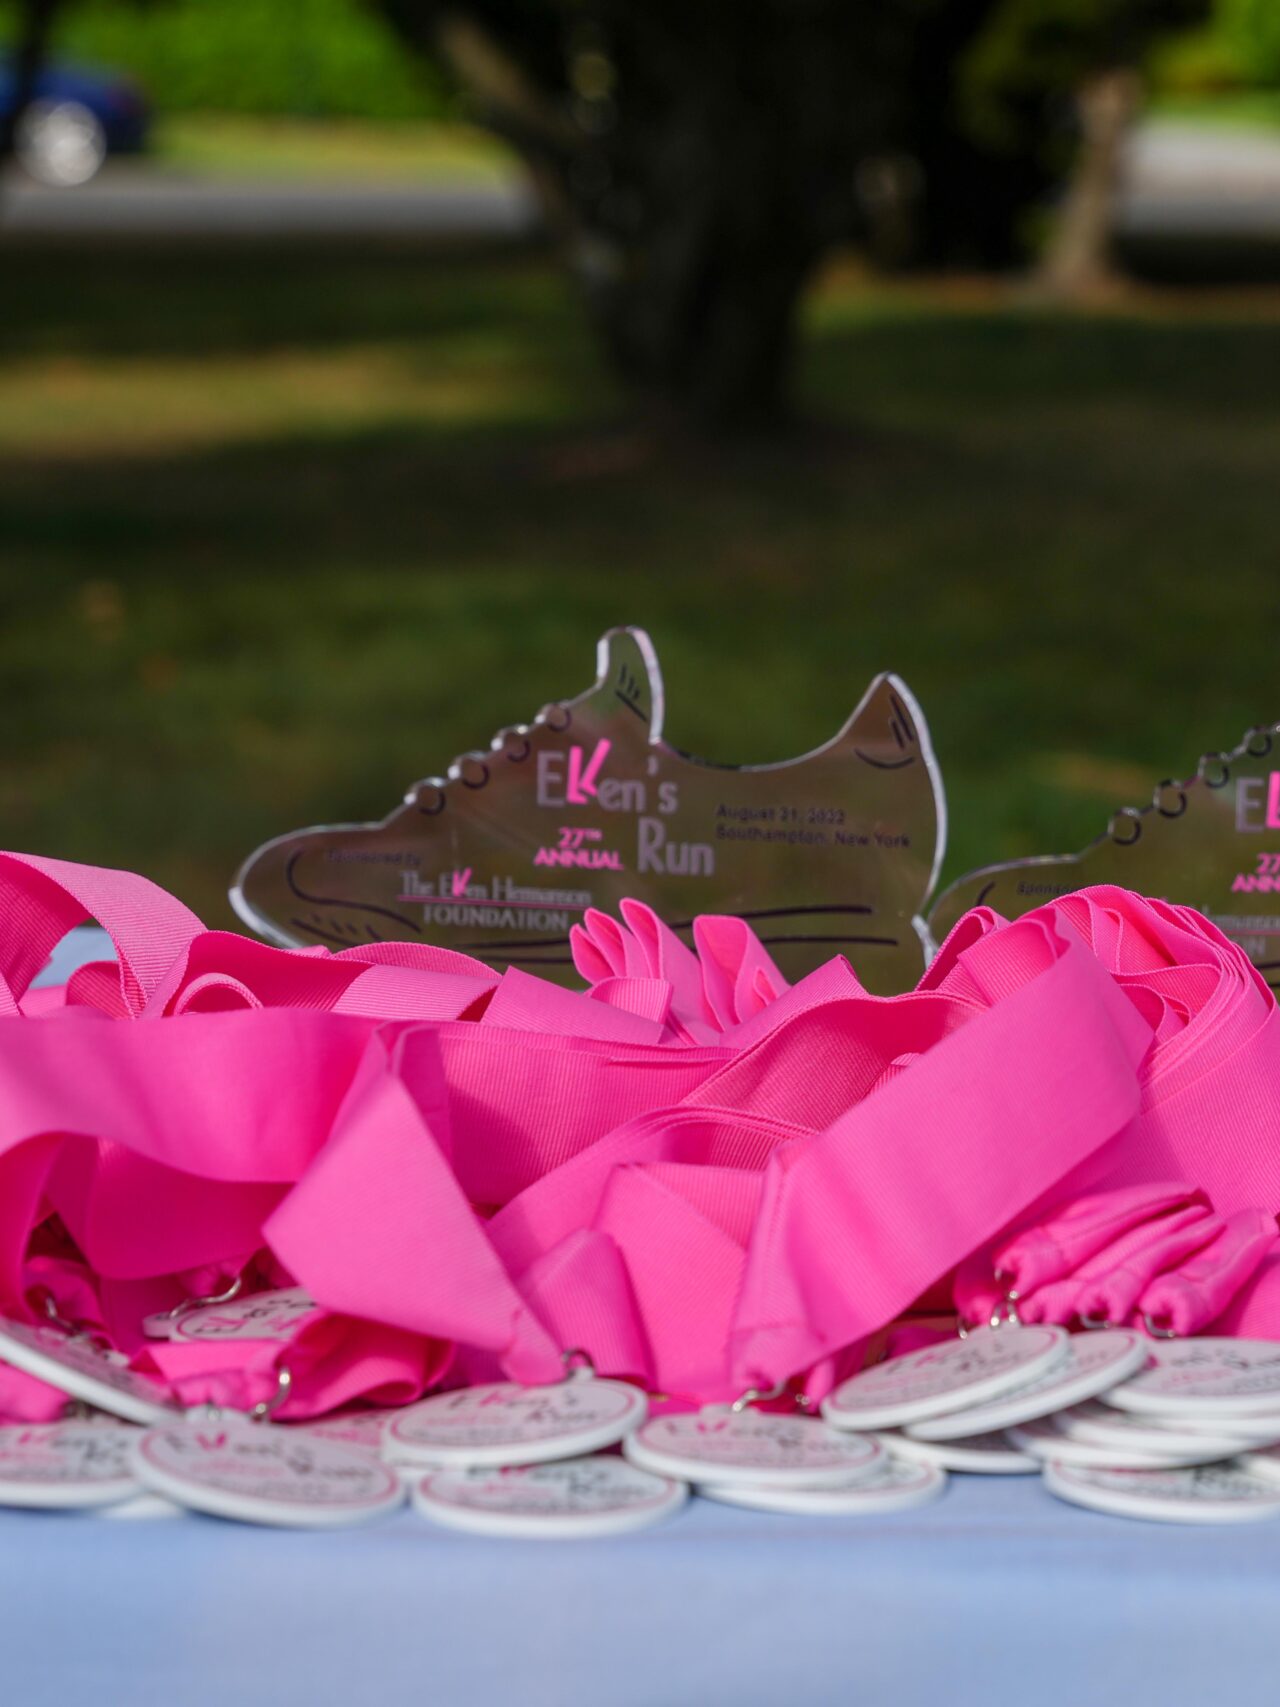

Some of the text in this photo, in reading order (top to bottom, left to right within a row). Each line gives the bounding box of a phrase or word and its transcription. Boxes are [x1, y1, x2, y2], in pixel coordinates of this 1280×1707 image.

[716, 804, 775, 823] August
[808, 807, 846, 825] 2022
[637, 817, 716, 877] Run
[835, 830, 869, 847] New
[874, 831, 911, 848] York
[533, 847, 625, 871] ANNUAL
[400, 869, 434, 897] The
[423, 904, 568, 932] FOUNDATION
